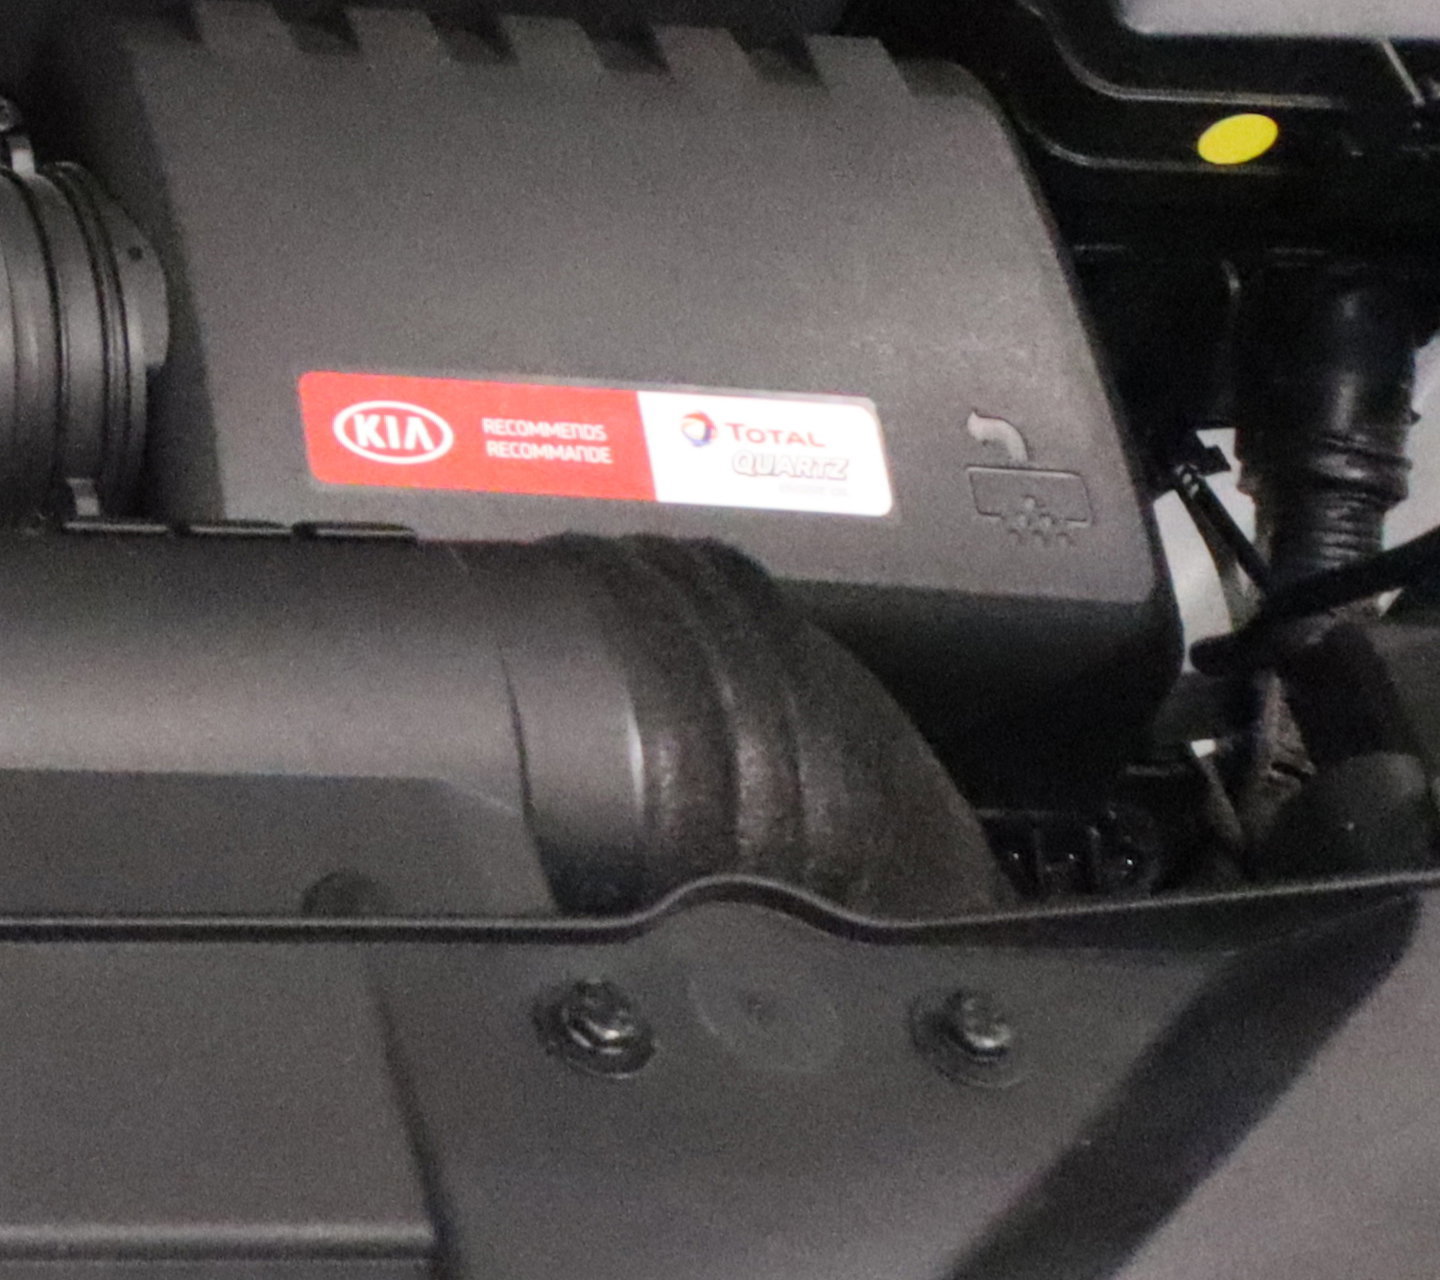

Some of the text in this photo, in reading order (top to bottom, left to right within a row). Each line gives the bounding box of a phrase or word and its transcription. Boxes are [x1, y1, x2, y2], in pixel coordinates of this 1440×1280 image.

[353, 413, 435, 451] KIA
[481, 417, 608, 441] RECOMMENDS
[724, 422, 827, 448] TOTAL
[485, 440, 613, 465] RECOMMANDE
[730, 450, 851, 481] QUARTZ
